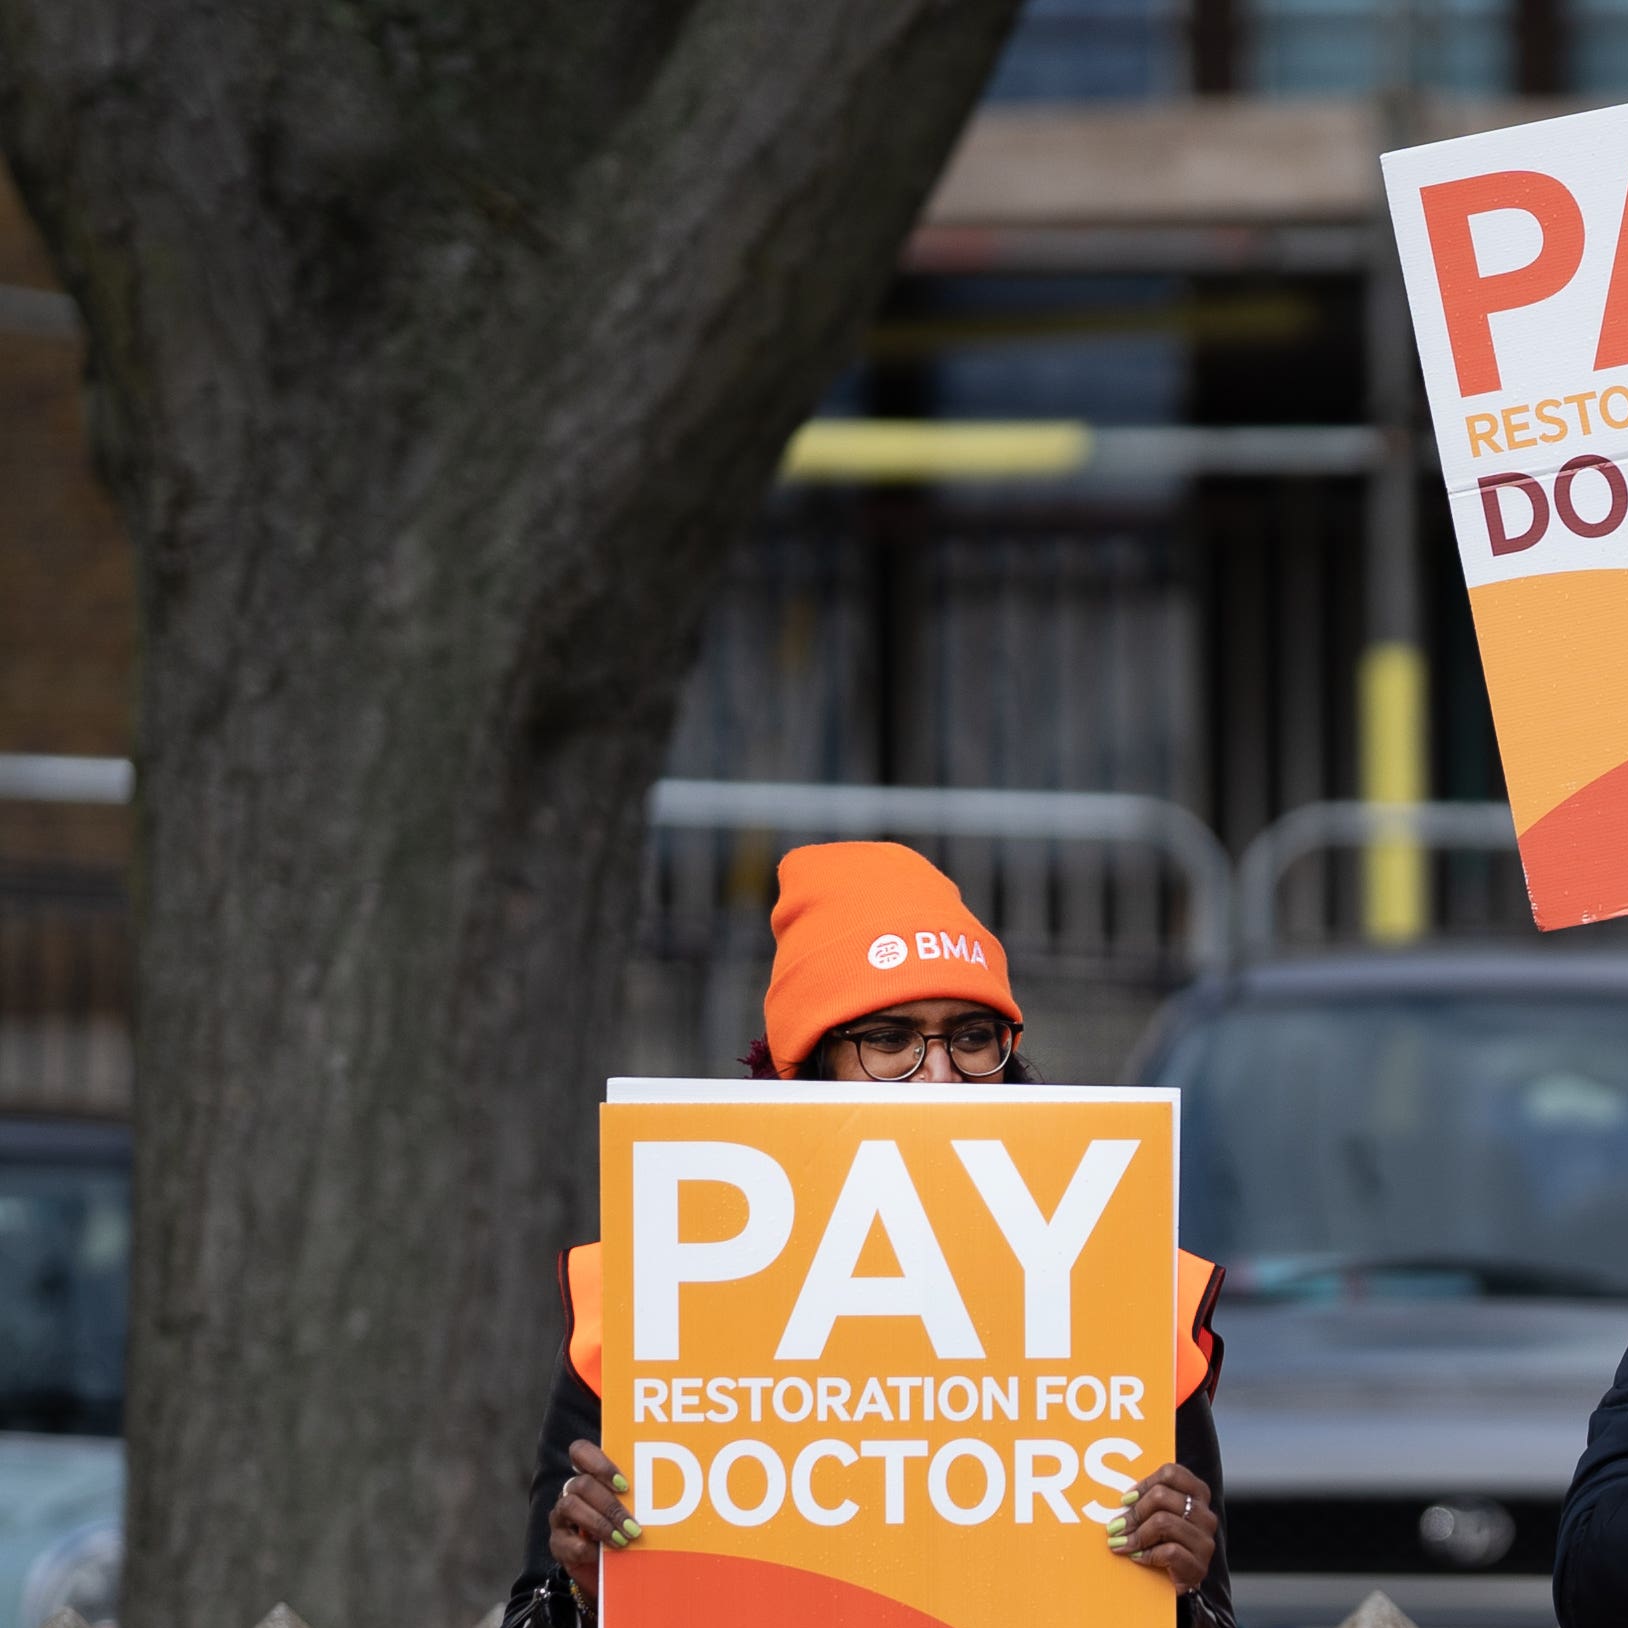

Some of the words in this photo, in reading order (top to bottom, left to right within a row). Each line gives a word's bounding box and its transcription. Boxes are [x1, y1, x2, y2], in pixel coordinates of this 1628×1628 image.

[915, 930, 989, 970] BMA
[633, 1139, 1141, 1361] PAY
[634, 1376, 1020, 1422] RESTORATION
[1036, 1375, 1144, 1421] FOR
[633, 1437, 1143, 1526] DOCTORS
